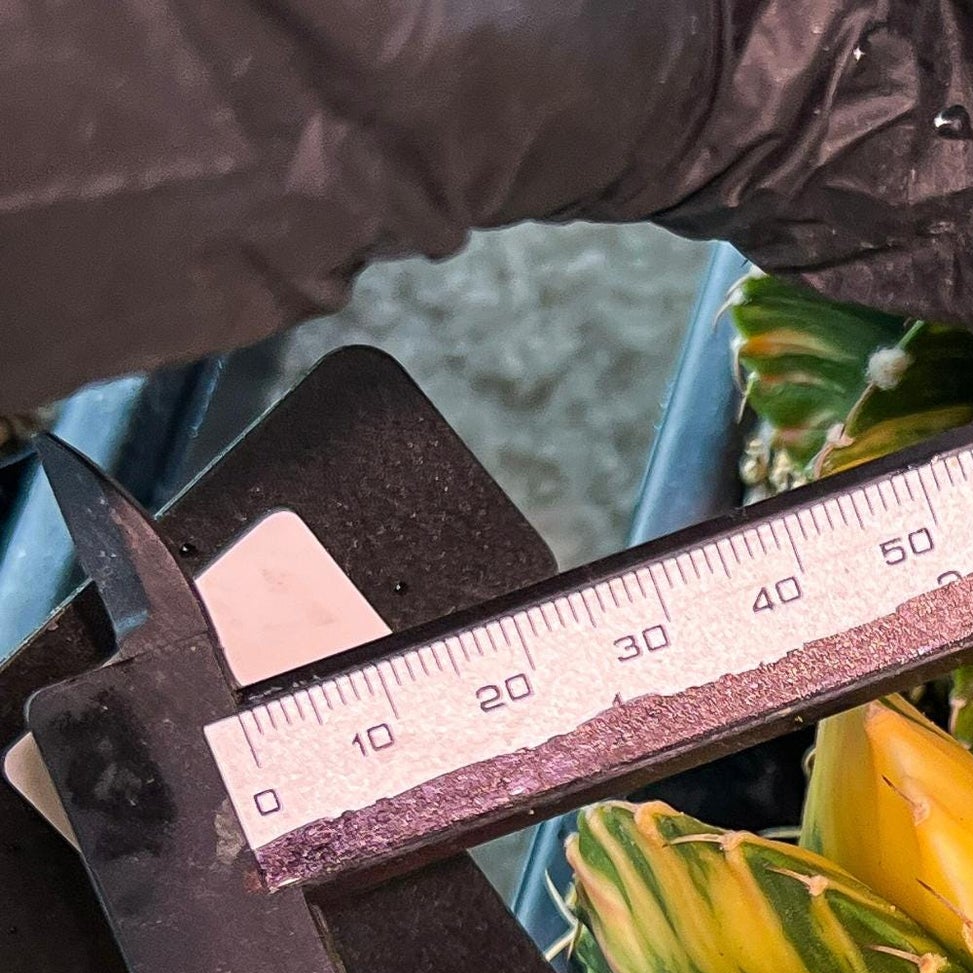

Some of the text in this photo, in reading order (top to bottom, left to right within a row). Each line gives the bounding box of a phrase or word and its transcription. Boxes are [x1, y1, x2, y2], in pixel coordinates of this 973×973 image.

[254, 789, 282, 816] 0
[351, 722, 394, 757] 10
[475, 672, 535, 712] 20
[613, 623, 670, 662] 30
[751, 576, 802, 613] 40
[879, 527, 934, 566] 50
